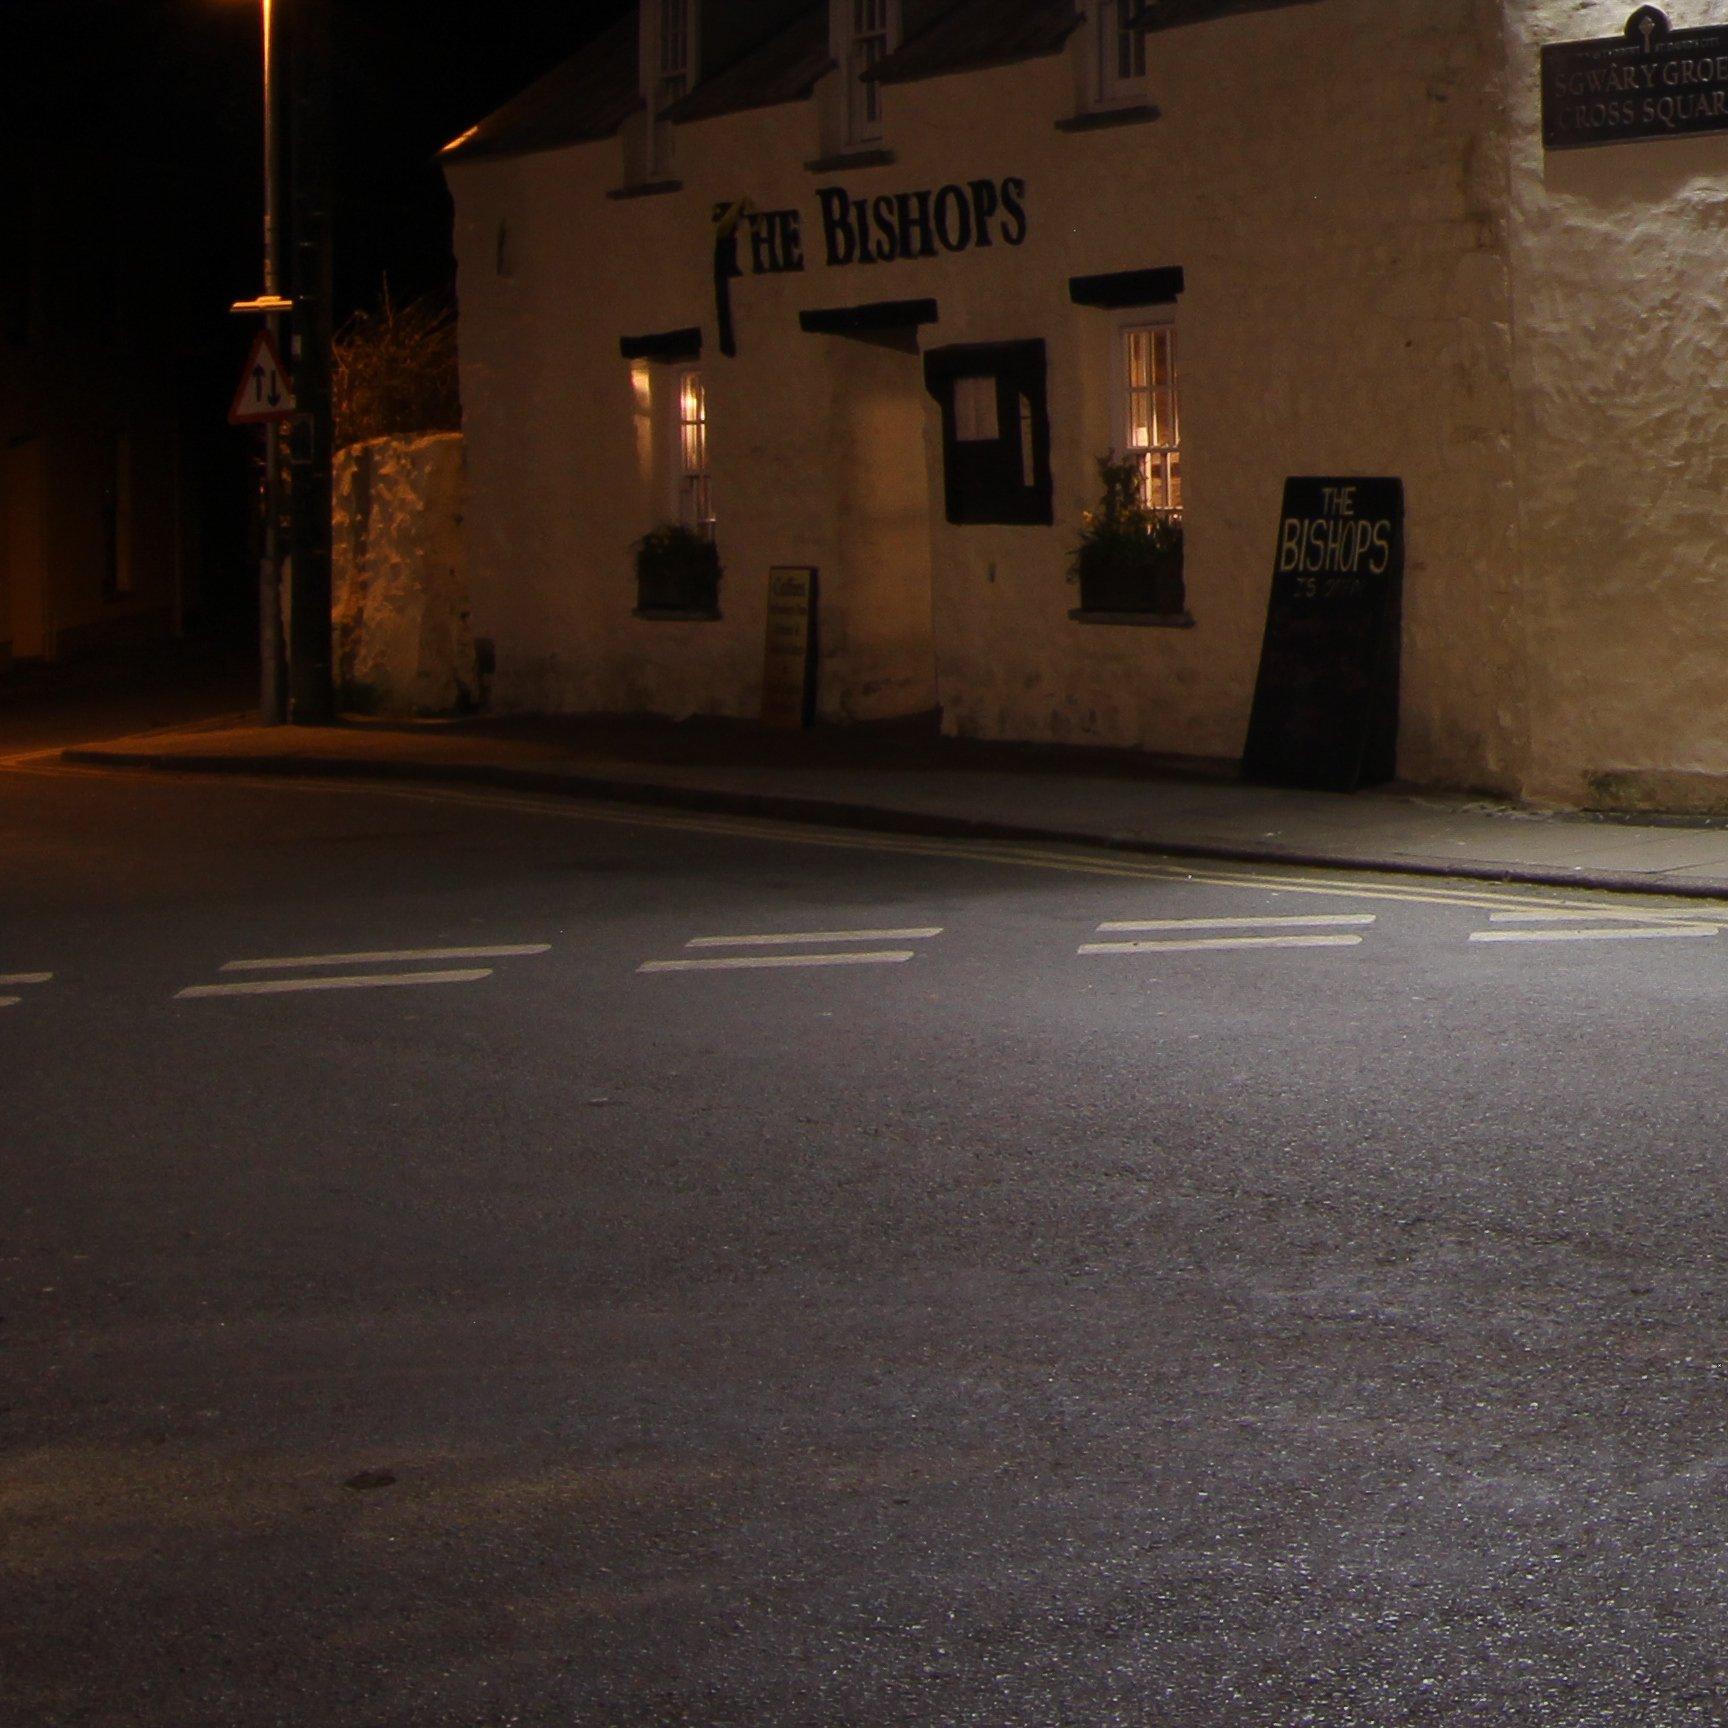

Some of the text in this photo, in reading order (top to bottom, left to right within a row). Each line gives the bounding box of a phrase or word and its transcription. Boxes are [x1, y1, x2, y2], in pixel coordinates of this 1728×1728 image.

[1554, 62, 1640, 97] SGWÂR
[1558, 100, 1635, 129] CROSS
[815, 176, 1027, 266] BISHOPS
[1321, 485, 1358, 516] THE
[1280, 518, 1393, 575] BISHOPS
